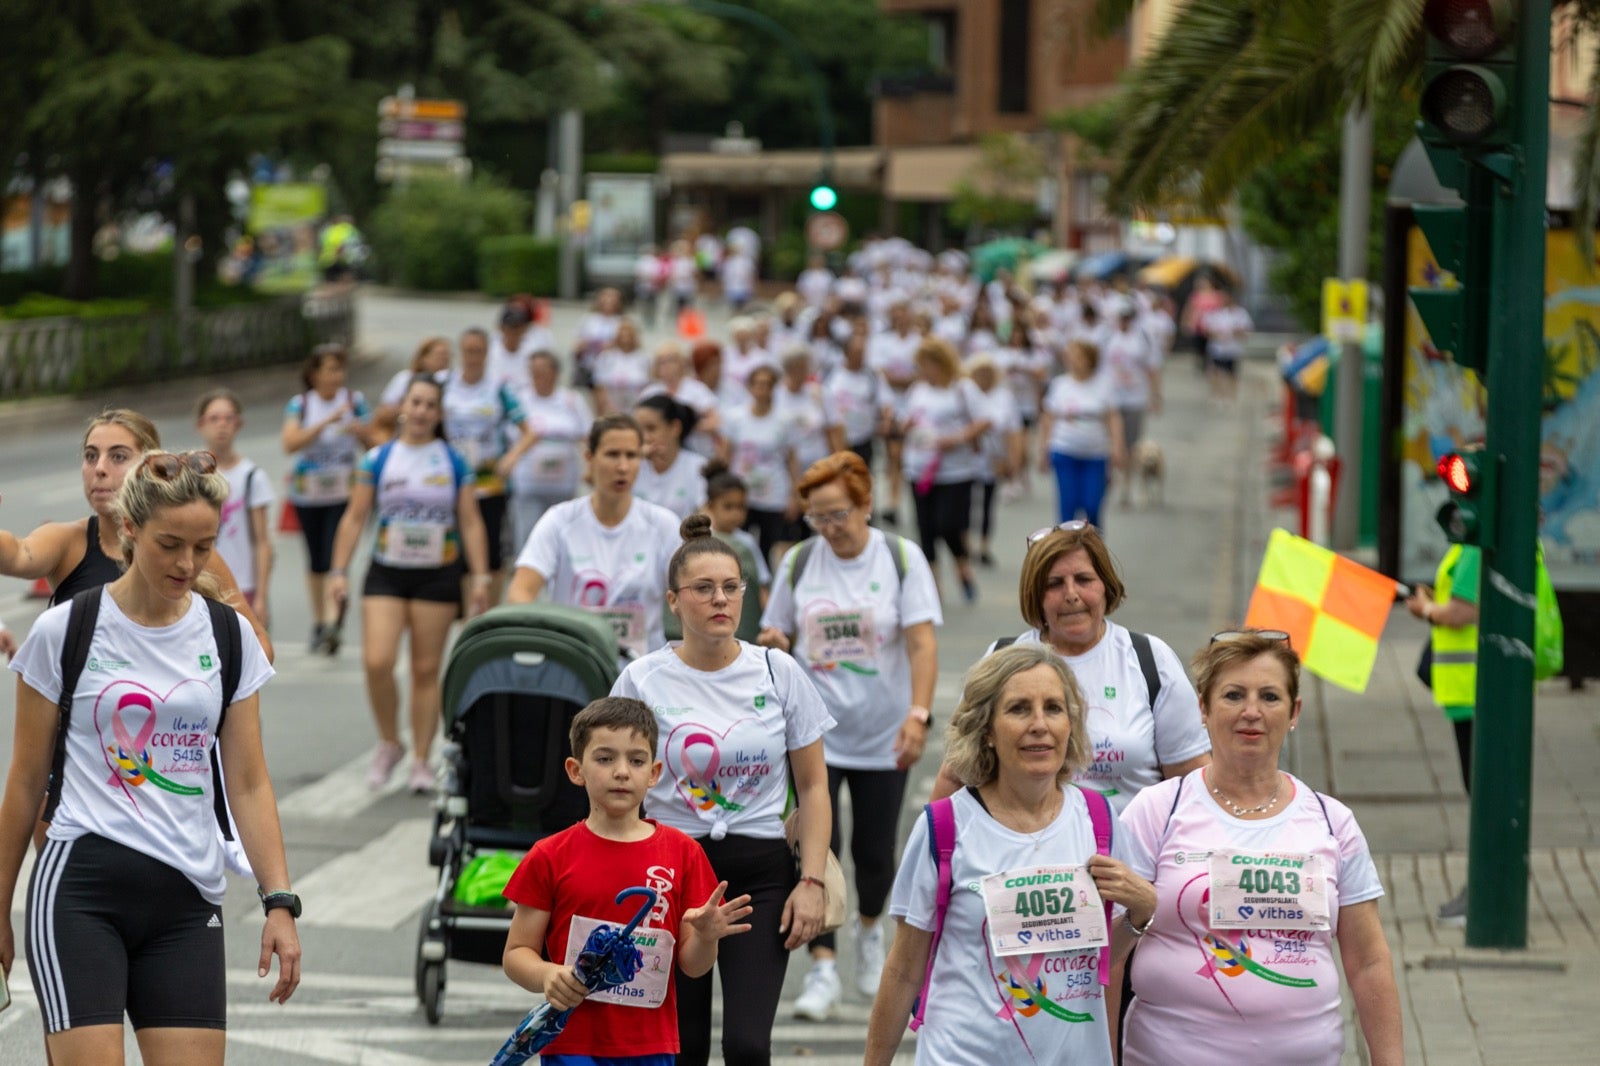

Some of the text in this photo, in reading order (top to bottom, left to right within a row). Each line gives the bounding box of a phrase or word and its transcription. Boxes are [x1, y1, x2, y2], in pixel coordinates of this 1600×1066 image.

[173, 749, 203, 762] 5415
[1231, 854, 1304, 869] COVIRAN
[1005, 873, 1074, 889] COVIRAN
[1238, 869, 1301, 895] 4043
[1015, 886, 1076, 918] 4052
[1258, 907, 1304, 920] vithas
[1036, 928, 1081, 943] vithas
[1274, 941, 1306, 953] 5415
